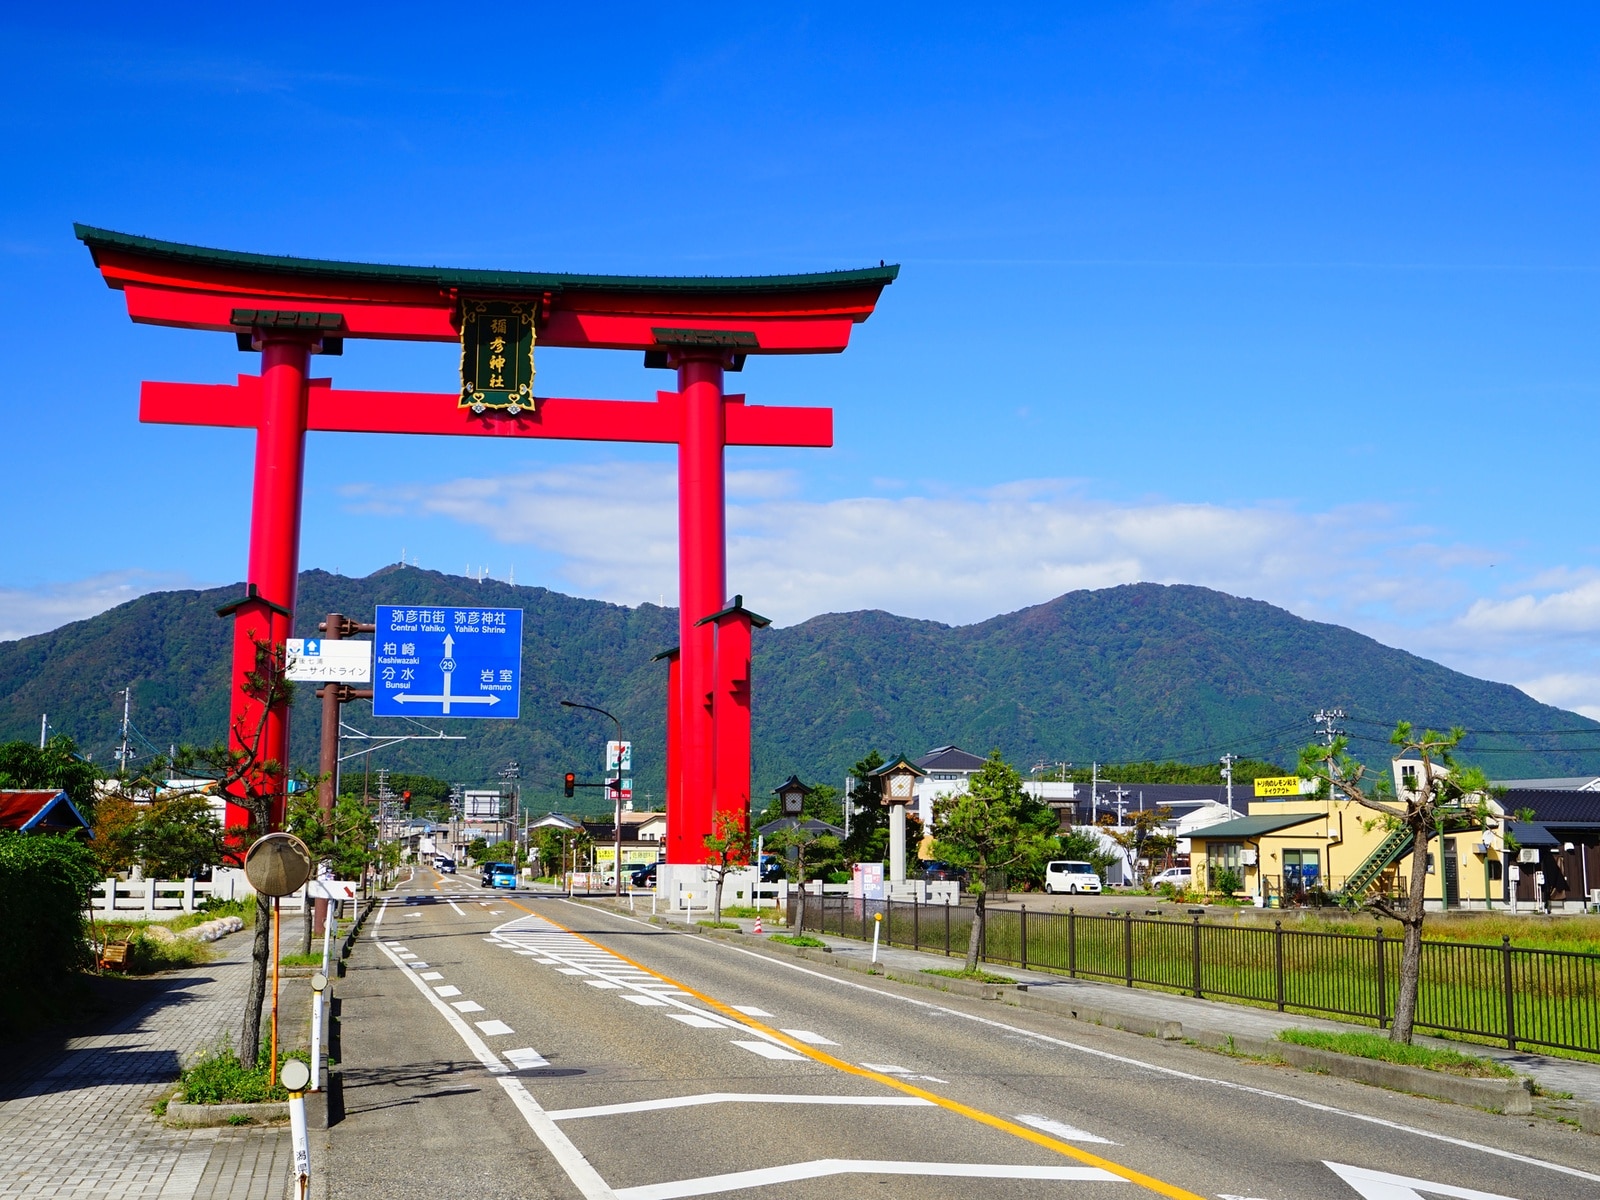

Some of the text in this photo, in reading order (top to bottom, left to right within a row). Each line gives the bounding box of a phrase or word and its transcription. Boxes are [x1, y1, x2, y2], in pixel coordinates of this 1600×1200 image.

[392, 609, 445, 624] 弥彦市街
[454, 611, 506, 626] 弥彦神社
[390, 623, 446, 633] Central Yahiko
[454, 625, 506, 634] Yahiko Shrine
[378, 657, 420, 665] Kashiwazaki
[443, 661, 453, 670] 29
[385, 681, 411, 689] Bunsui
[480, 683, 512, 691] Iwamuro
